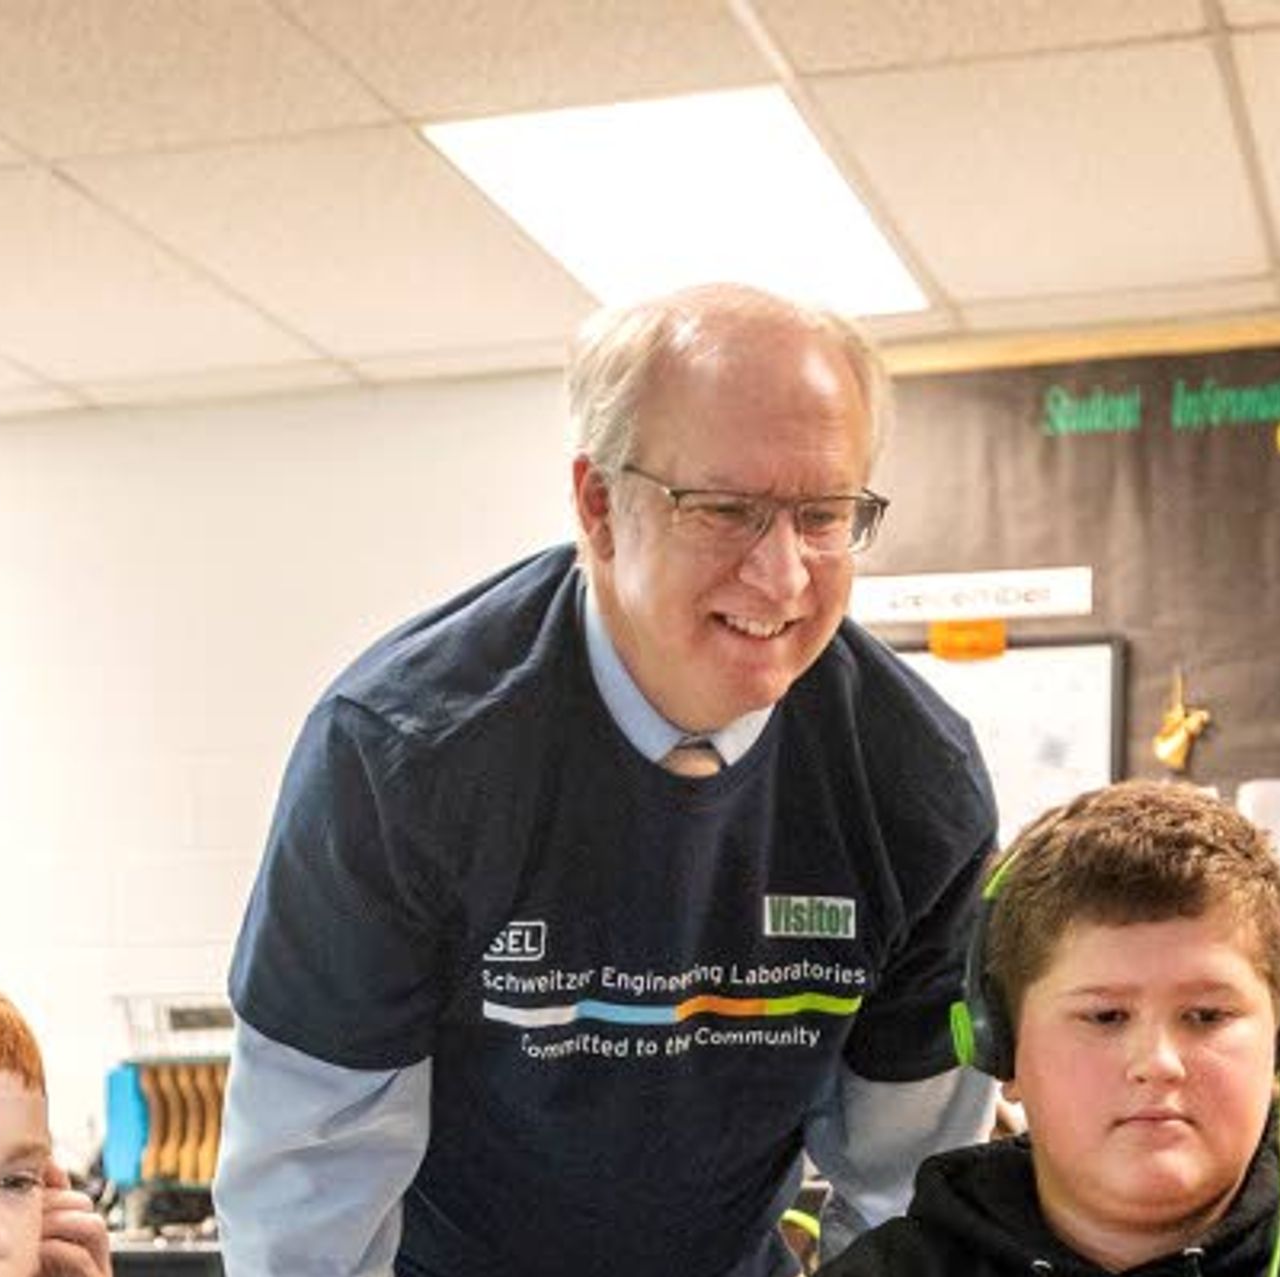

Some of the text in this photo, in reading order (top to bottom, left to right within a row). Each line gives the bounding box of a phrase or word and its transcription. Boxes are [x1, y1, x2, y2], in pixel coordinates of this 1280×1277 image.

[769, 898, 853, 936] Visitor
[488, 929, 540, 955] SEL
[730, 958, 867, 985] Laboratories
[636, 1034, 658, 1055] to
[694, 1025, 821, 1048] Community
